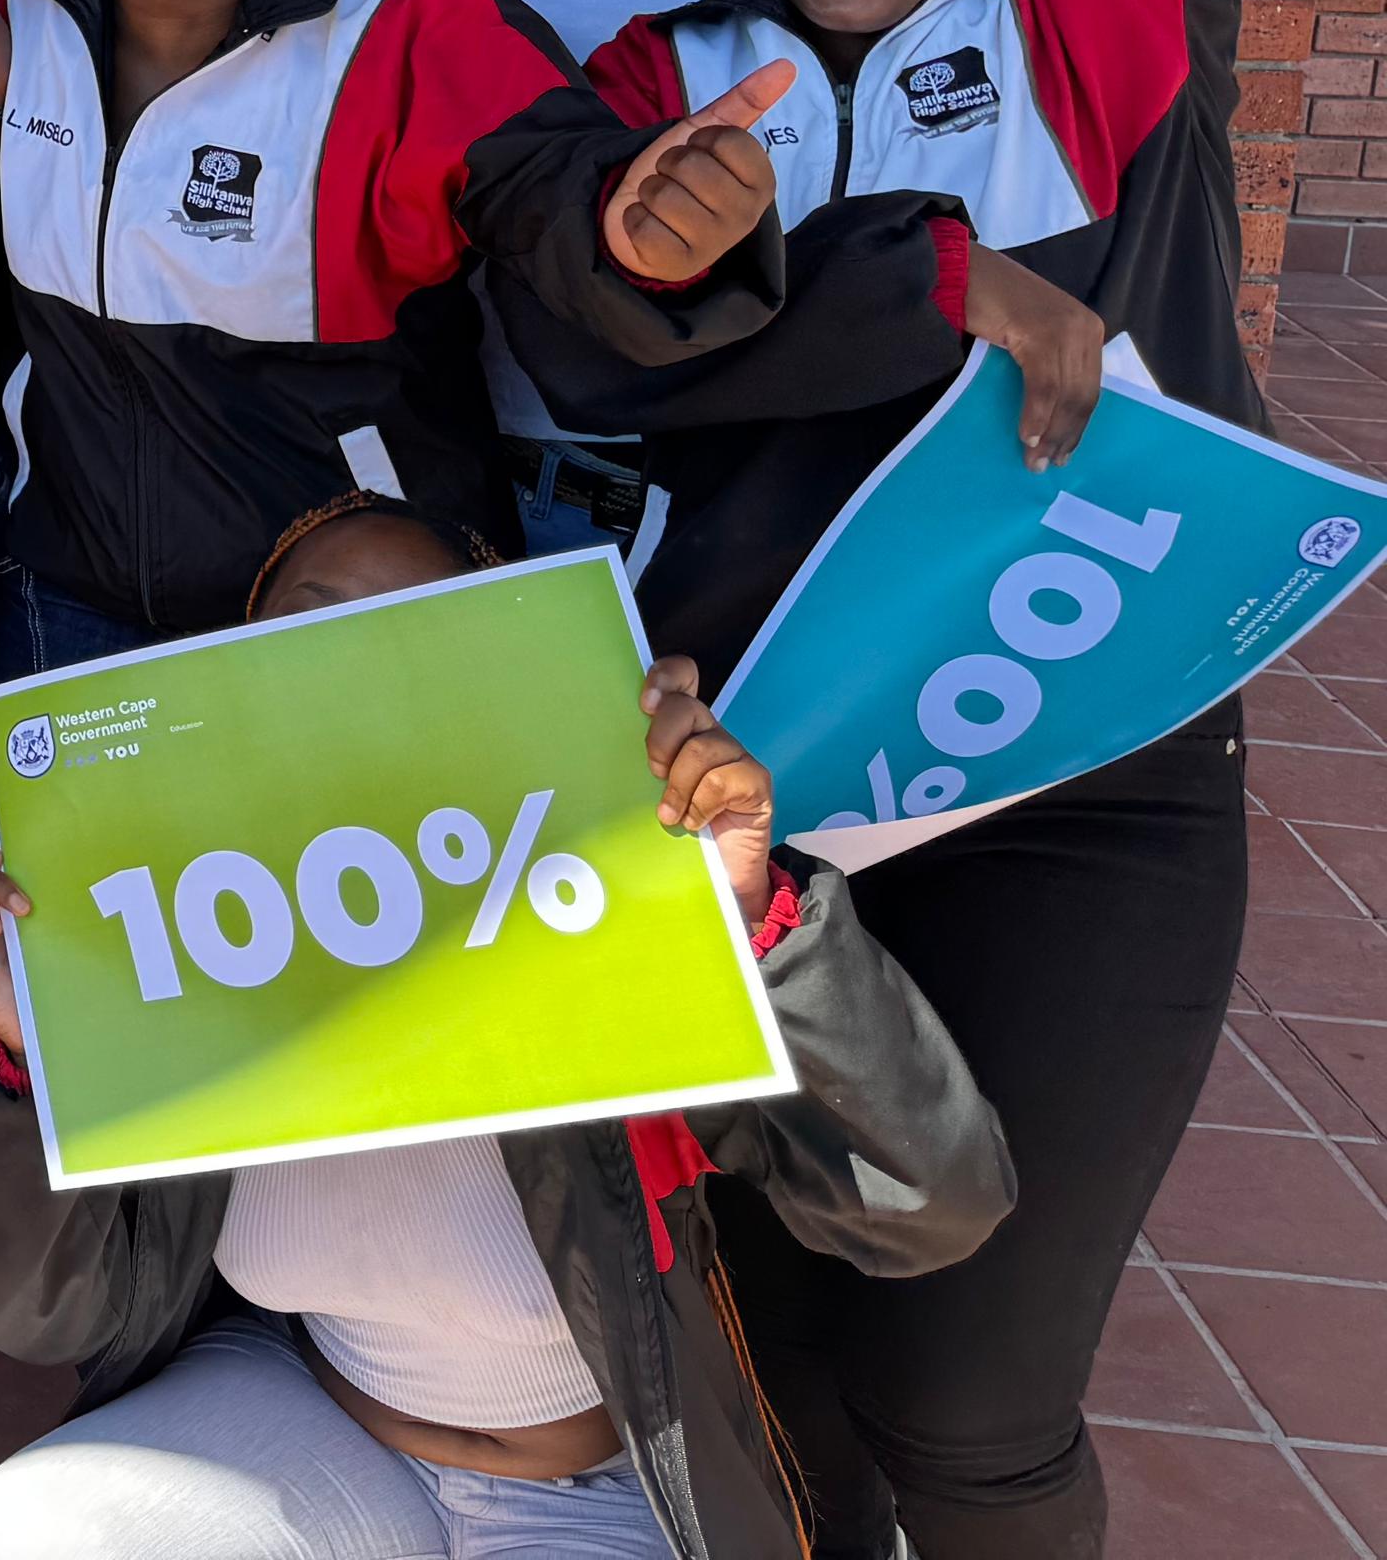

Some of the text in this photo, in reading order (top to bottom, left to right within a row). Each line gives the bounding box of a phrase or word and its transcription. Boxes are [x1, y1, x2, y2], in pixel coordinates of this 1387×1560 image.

[910, 82, 993, 109] Silikamva
[912, 92, 994, 117] High School
[187, 193, 250, 217] High School
[188, 180, 253, 206] Silikamva
[1226, 597, 1260, 627] YOU
[1232, 568, 1309, 642] Government
[1233, 571, 1325, 656] Western Cape
[55, 697, 157, 729] Western Cape
[59, 716, 148, 745] Government
[104, 742, 140, 761] YOU
[88, 789, 606, 1002] 100%
